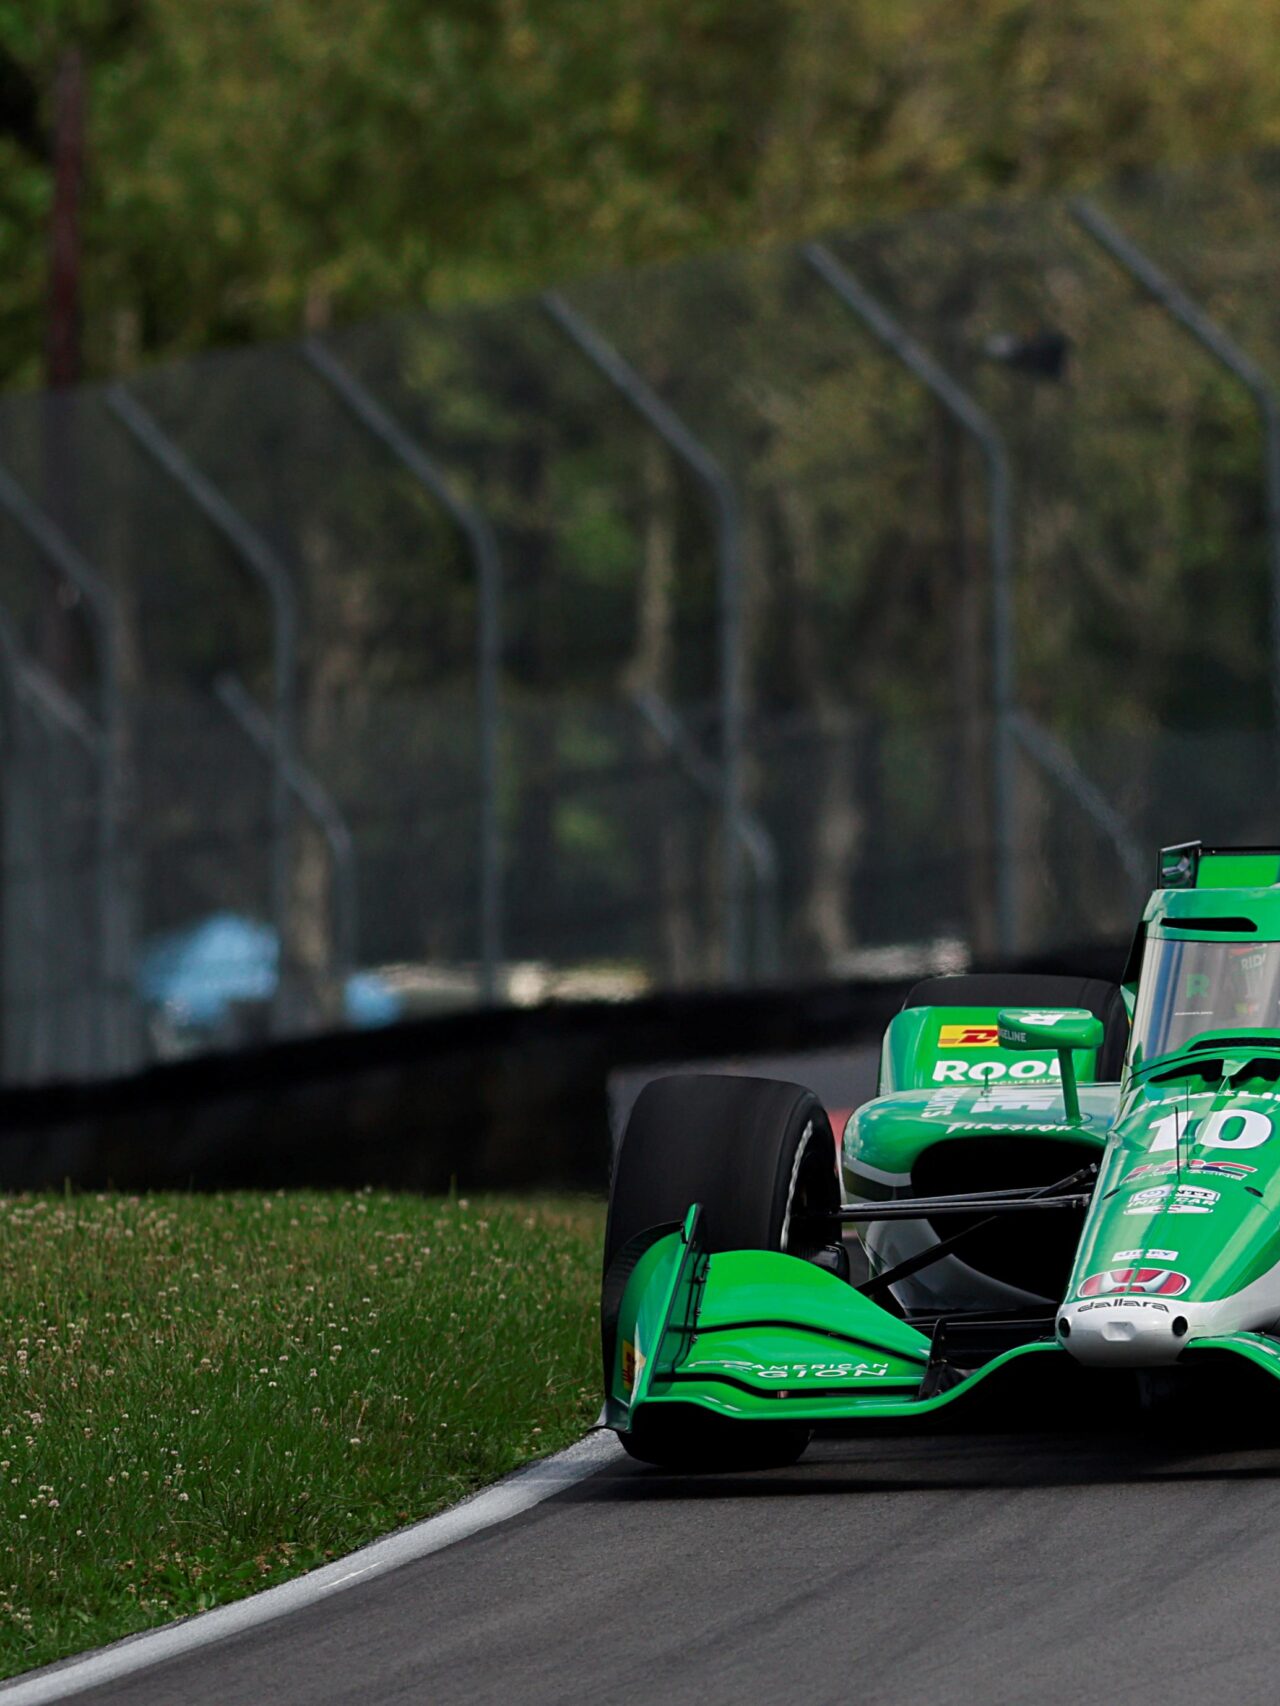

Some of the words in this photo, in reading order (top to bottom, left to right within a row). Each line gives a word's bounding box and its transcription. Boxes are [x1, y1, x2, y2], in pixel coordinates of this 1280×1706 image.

[1147, 1109, 1273, 1153] 10
[1077, 1298, 1170, 1314] dallara
[751, 1362, 889, 1370] AMERICAN
